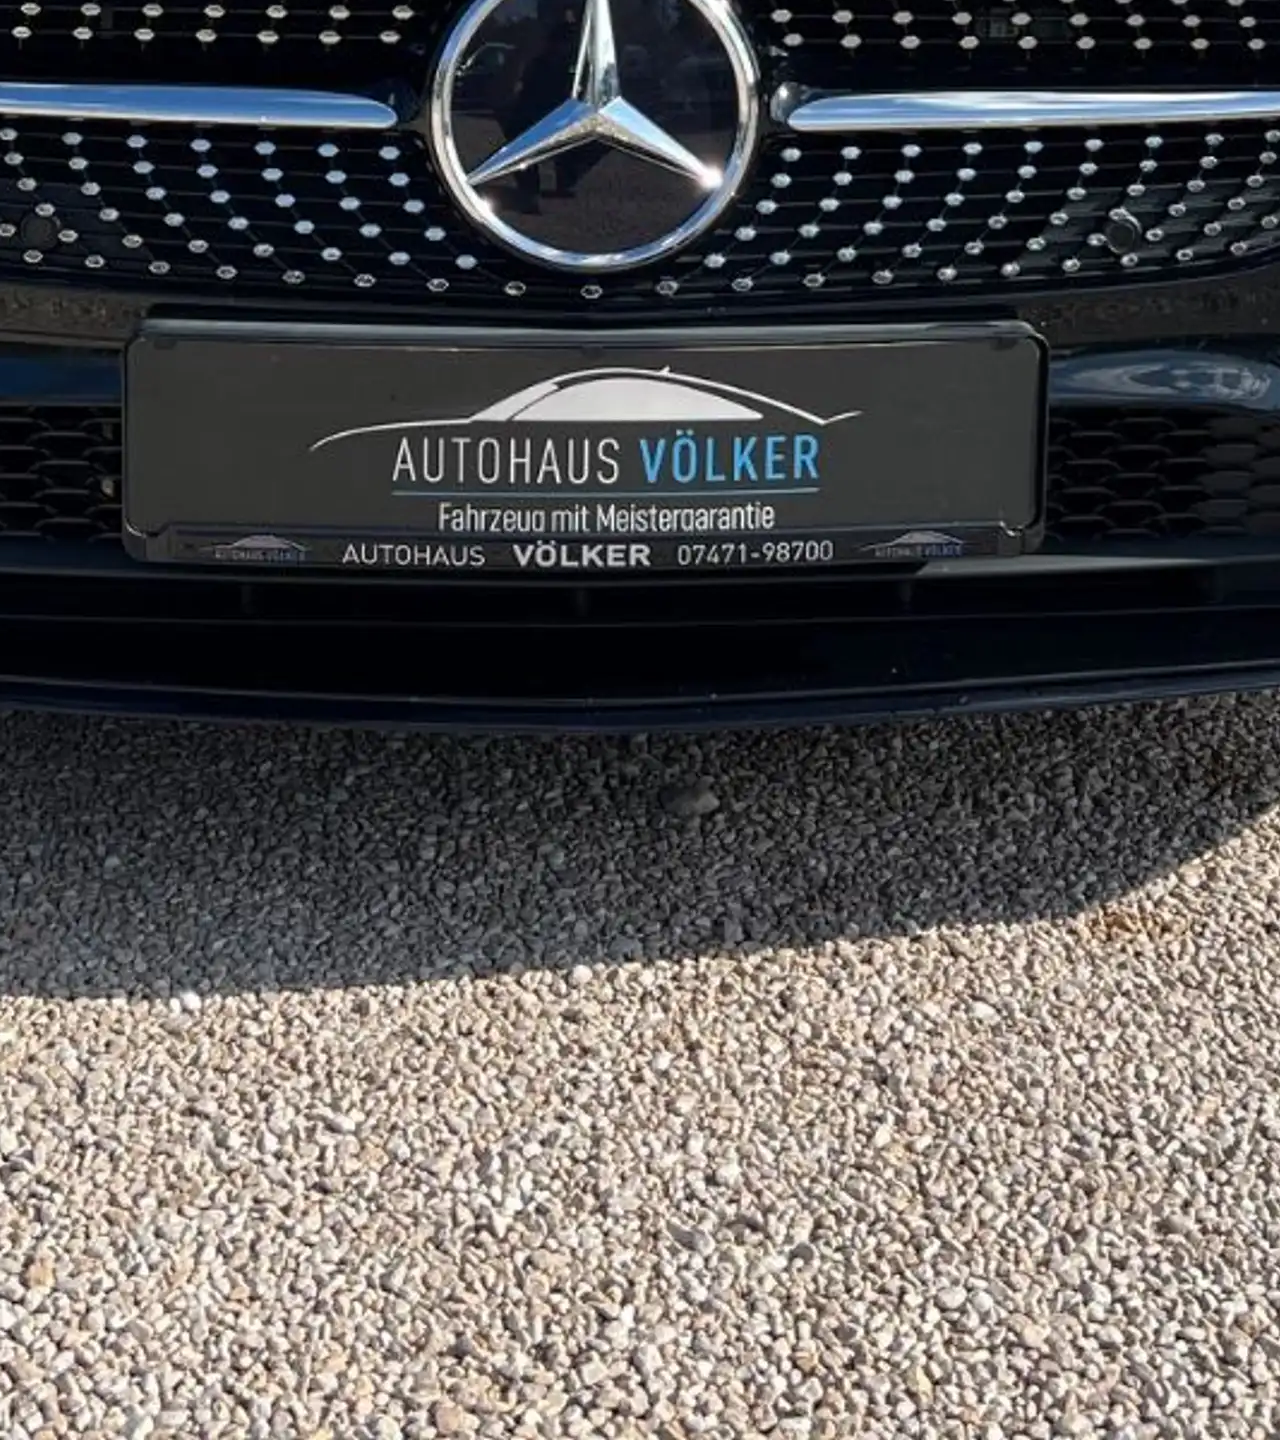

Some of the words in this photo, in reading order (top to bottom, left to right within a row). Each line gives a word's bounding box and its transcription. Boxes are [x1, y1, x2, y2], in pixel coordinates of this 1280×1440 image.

[392, 436, 620, 485] AUTOHAUS
[638, 428, 819, 484] VÖLKER
[438, 502, 546, 532] Fahrzeug
[550, 503, 591, 533] mit
[595, 501, 776, 533] Meistergarantie
[342, 542, 486, 567] AUTOHAUS
[512, 539, 652, 568] VÖLKER
[677, 540, 834, 566] 07471-98700
